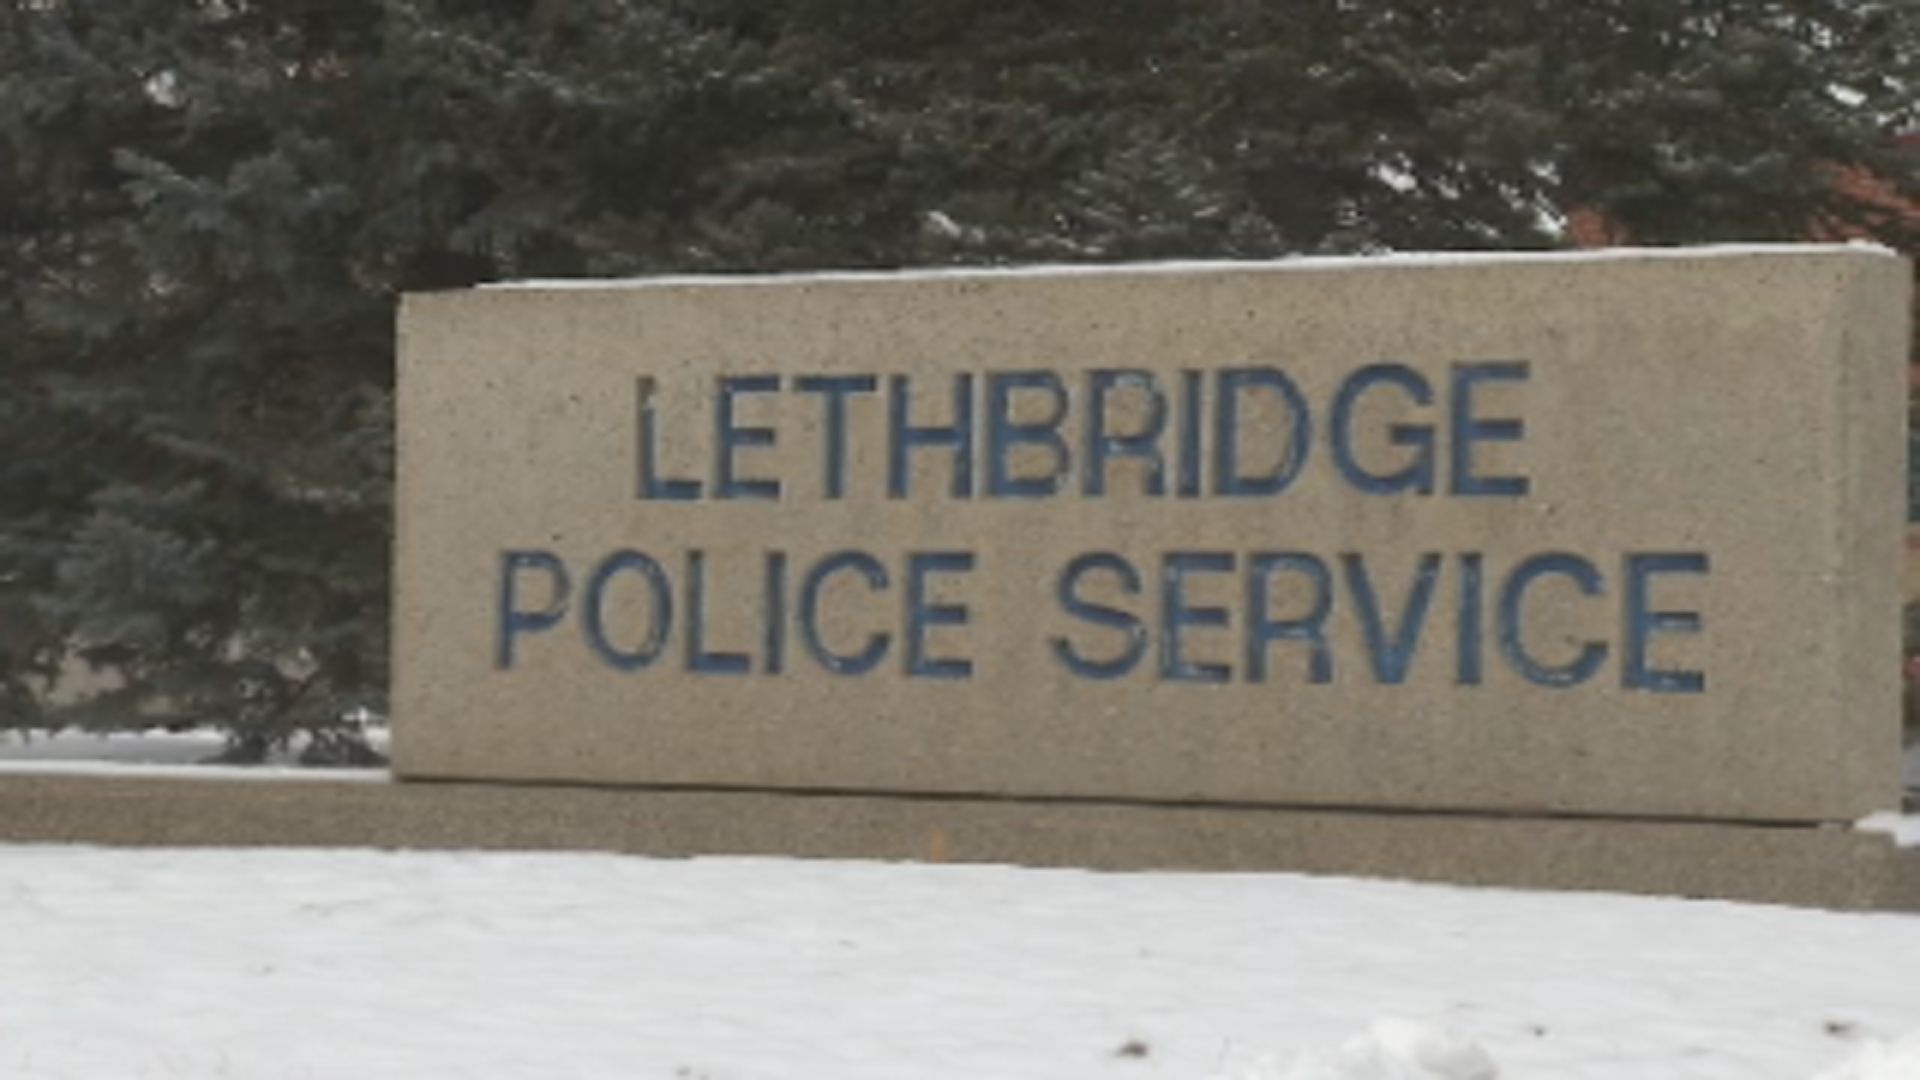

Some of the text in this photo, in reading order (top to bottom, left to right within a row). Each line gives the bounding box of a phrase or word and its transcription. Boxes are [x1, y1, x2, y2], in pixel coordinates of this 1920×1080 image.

[635, 361, 1532, 500] LETHBRIDGE
[495, 550, 1709, 693] POLICE SERVICE
